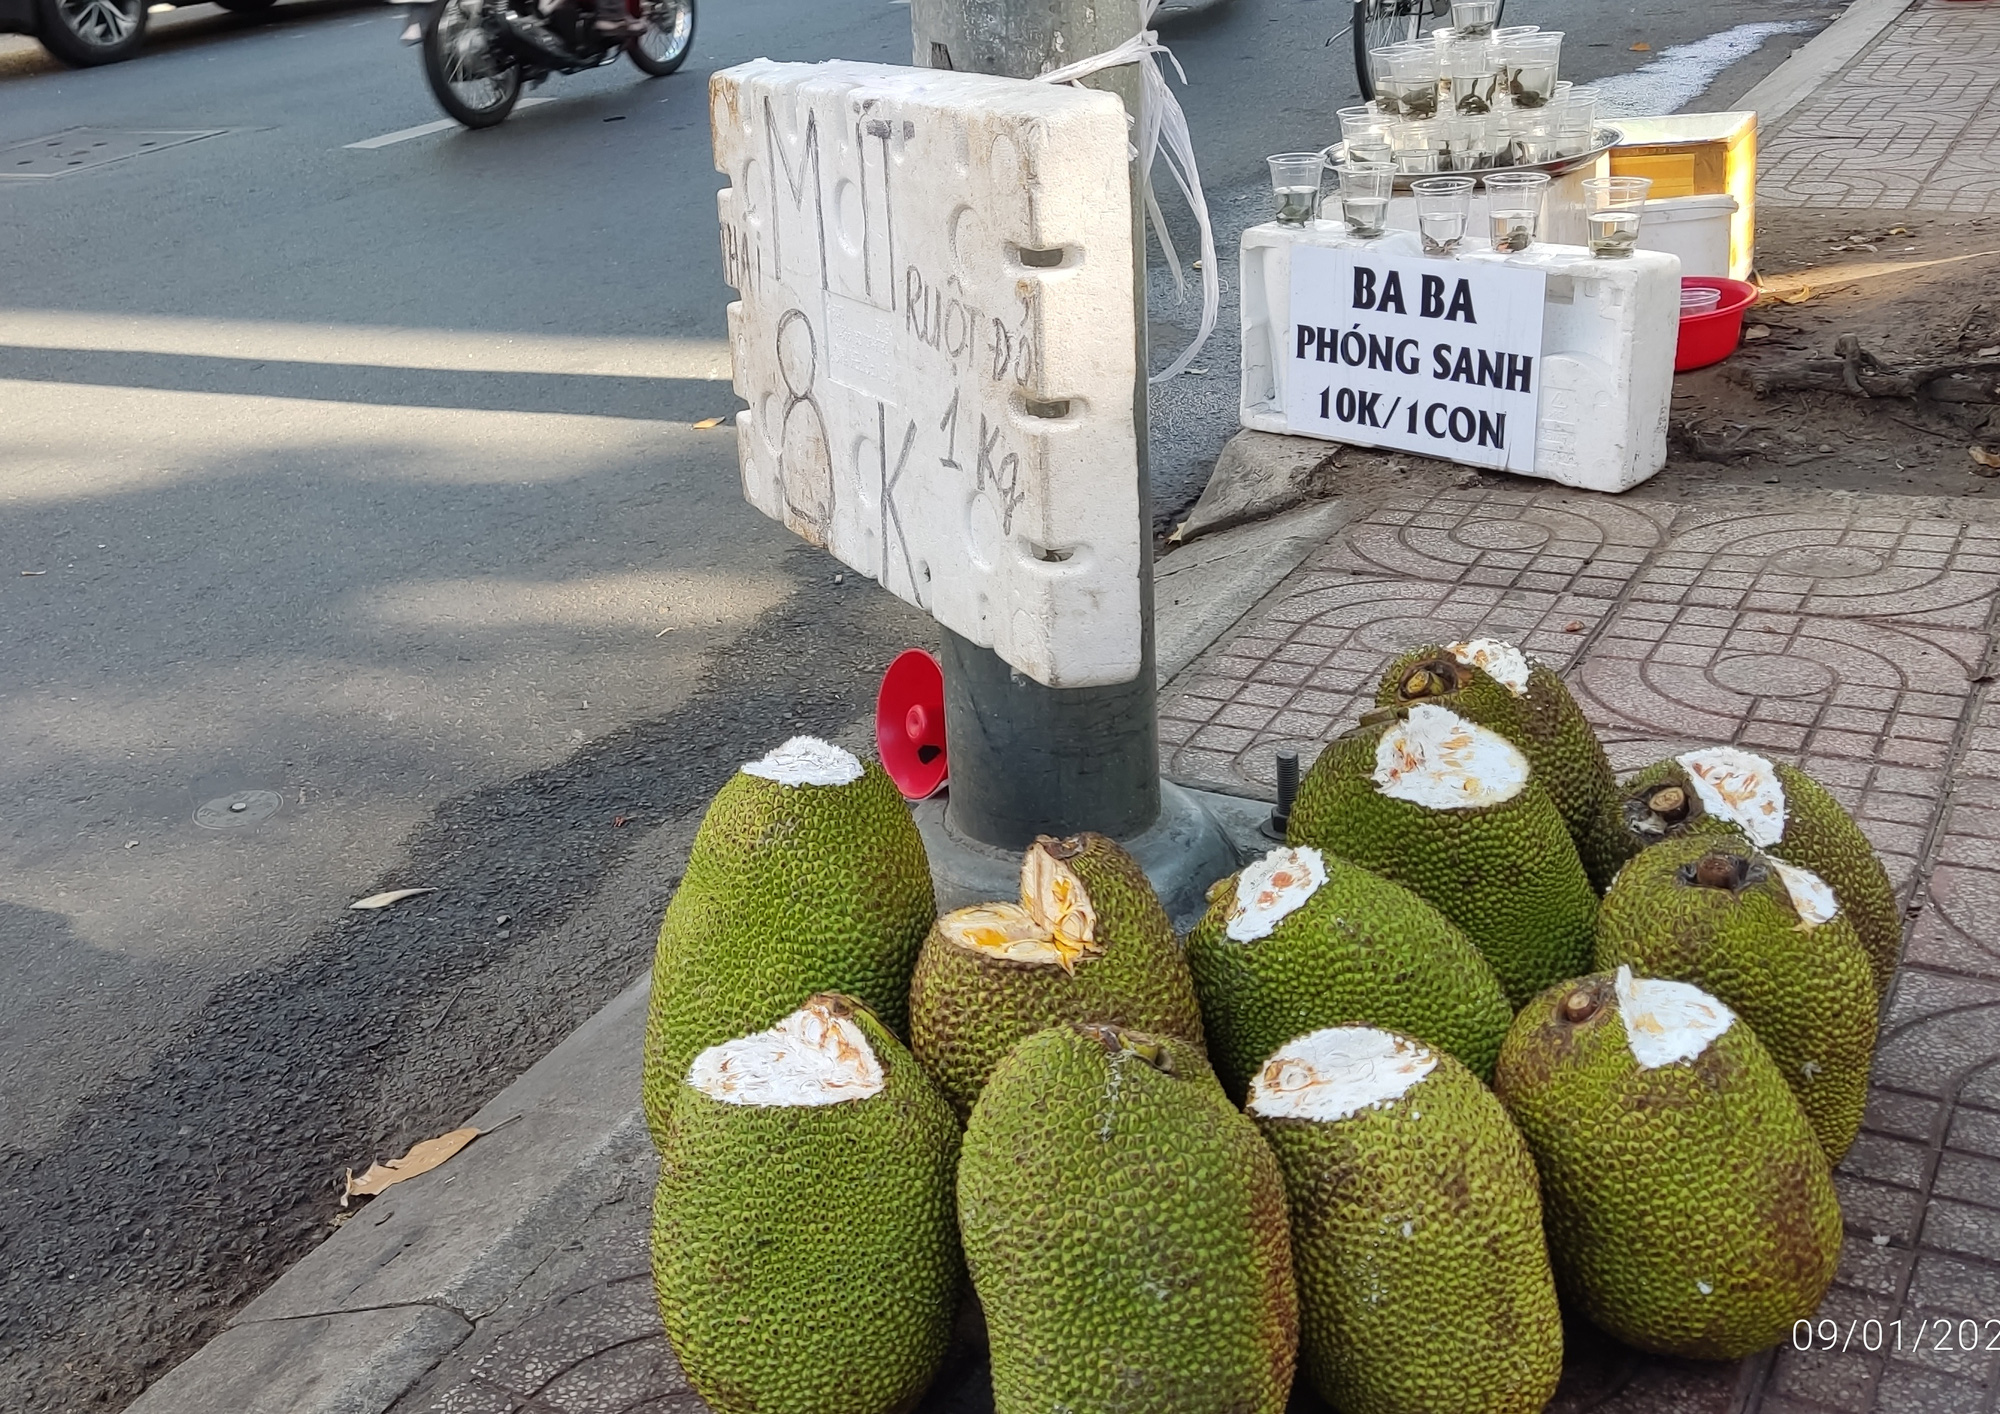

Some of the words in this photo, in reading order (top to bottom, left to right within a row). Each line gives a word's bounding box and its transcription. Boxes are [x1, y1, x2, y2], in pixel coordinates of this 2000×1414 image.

[763, 96, 916, 313] MÍT
[1352, 266, 1407, 315] BA
[1419, 273, 1478, 325] BA
[1296, 323, 1420, 375] PHÓNG
[1432, 343, 1533, 394] SANH
